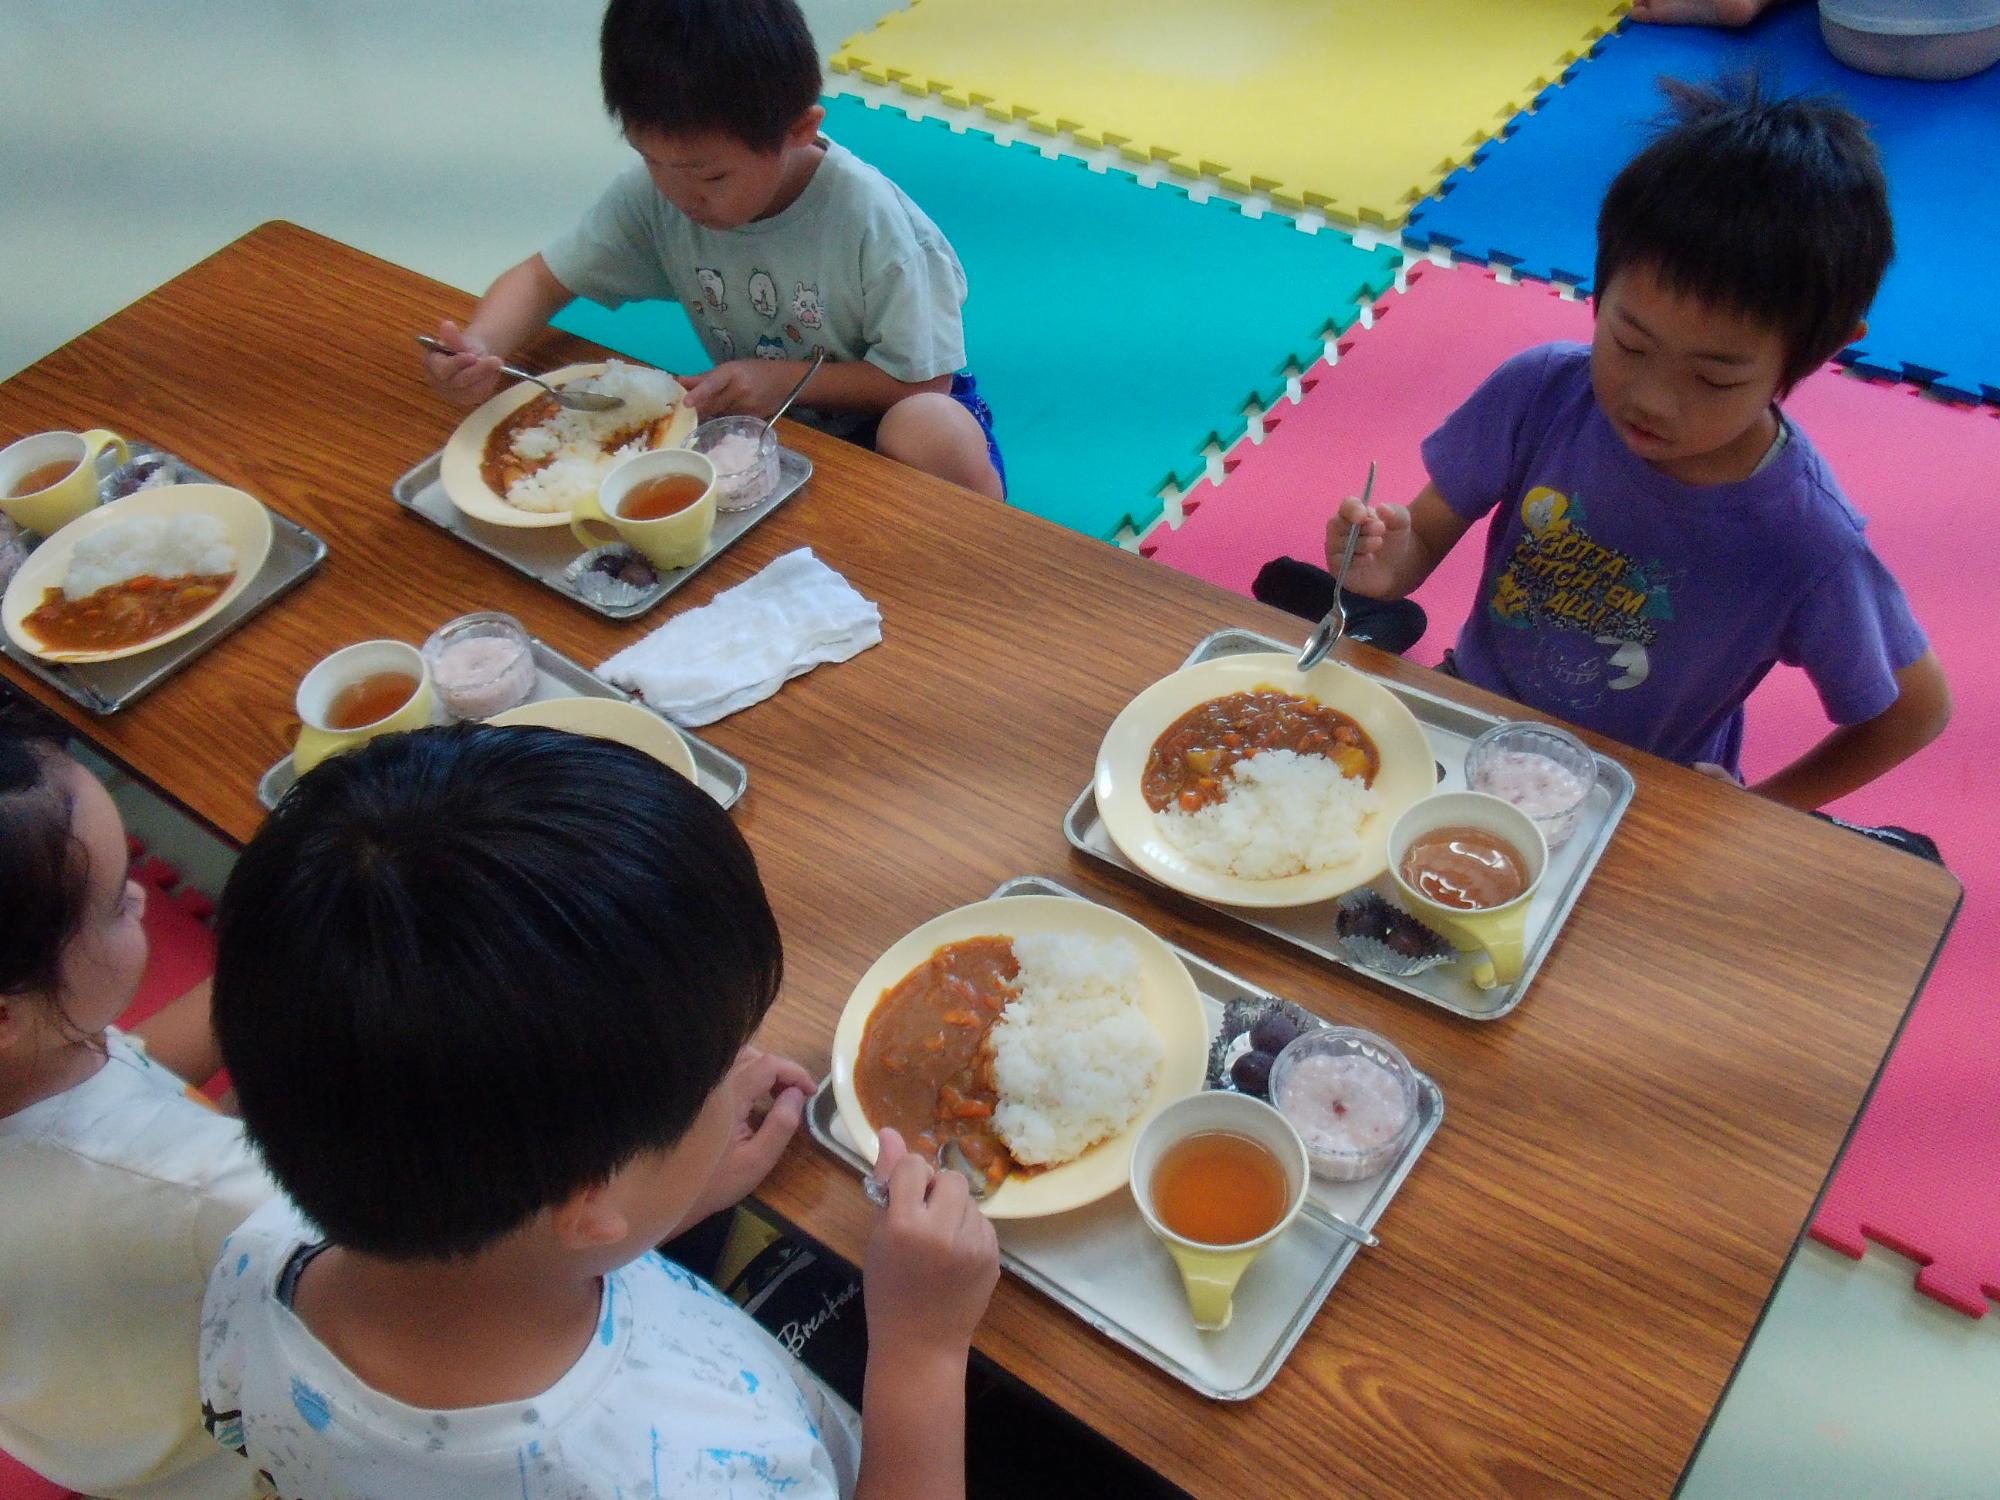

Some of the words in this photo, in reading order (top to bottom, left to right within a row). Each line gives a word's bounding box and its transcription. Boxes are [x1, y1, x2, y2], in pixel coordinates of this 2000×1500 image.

[1516, 544, 1600, 591] CATCH
[1540, 530, 1625, 580] GOTTA
[1543, 590, 1606, 627] ALL!
